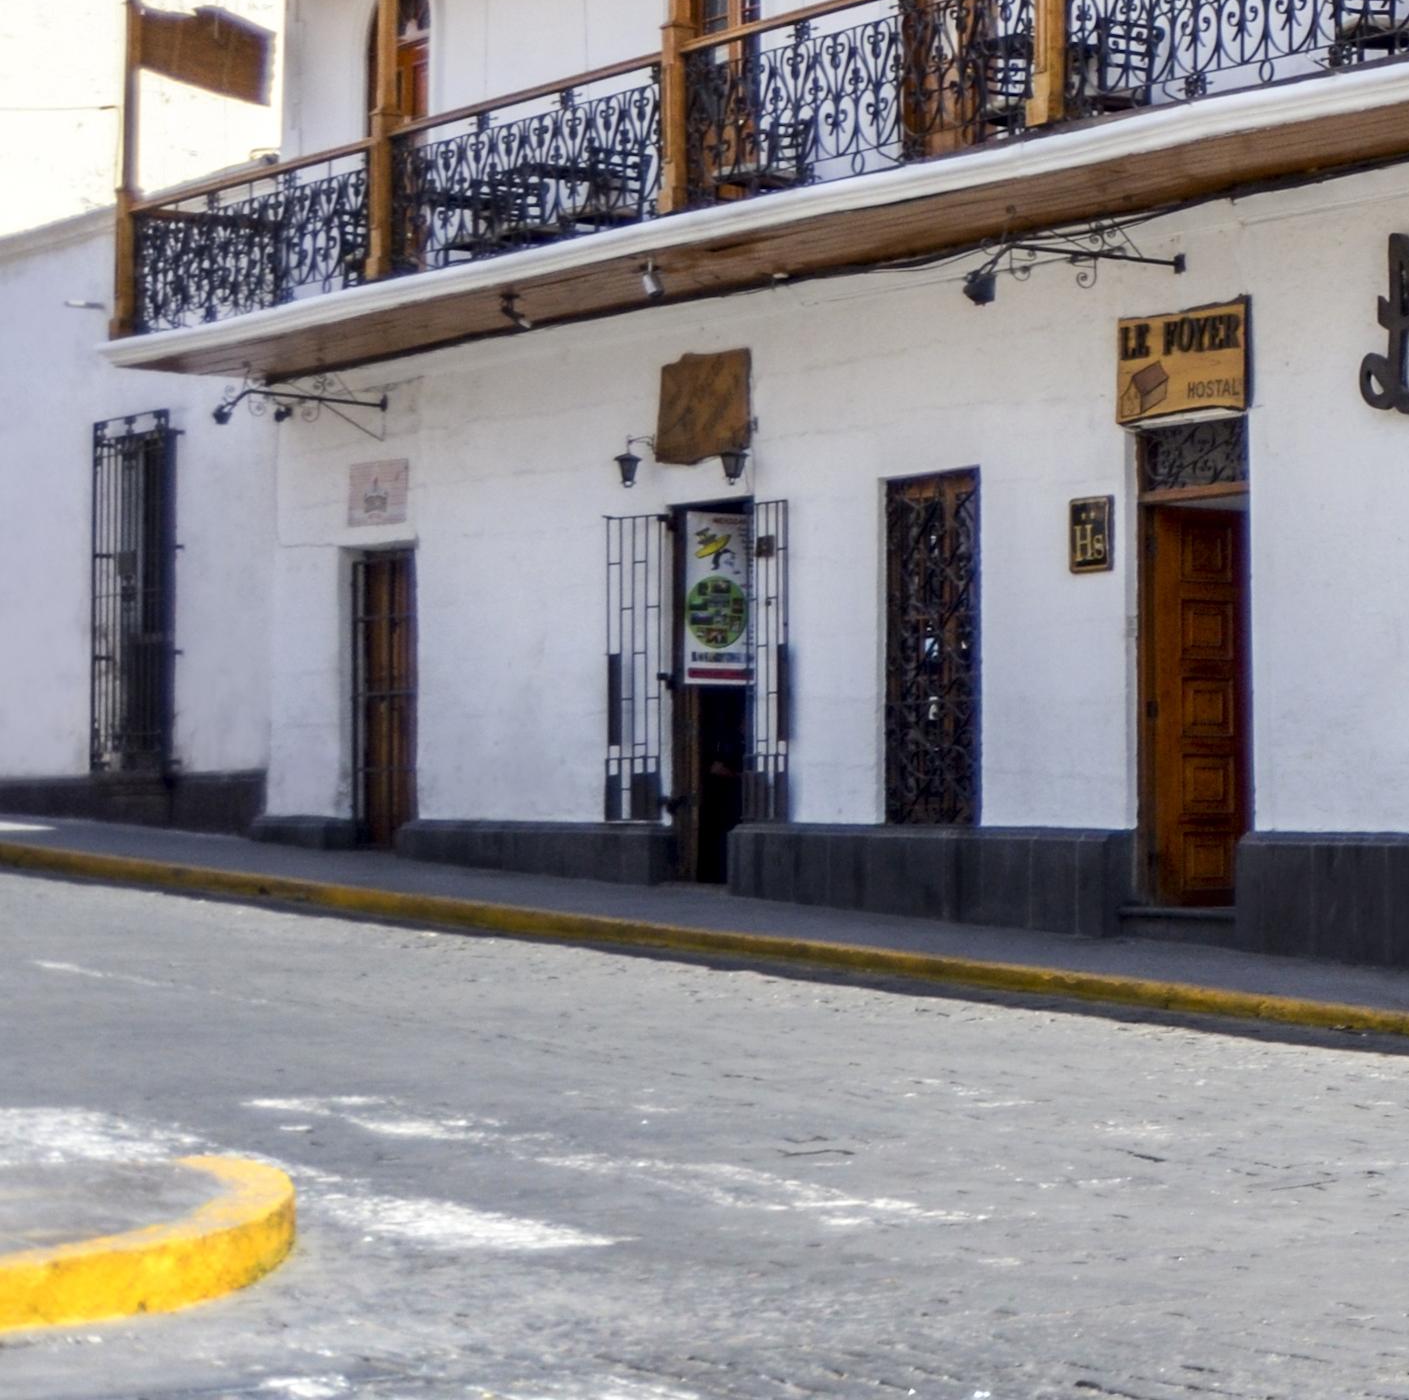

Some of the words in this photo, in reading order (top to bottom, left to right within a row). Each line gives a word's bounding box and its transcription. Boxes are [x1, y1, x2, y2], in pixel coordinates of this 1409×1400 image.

[1120, 323, 1151, 361] LE
[1162, 313, 1240, 356] FOYER
[1187, 378, 1240, 400] HOSTAL
[1073, 524, 1105, 562] Hs
